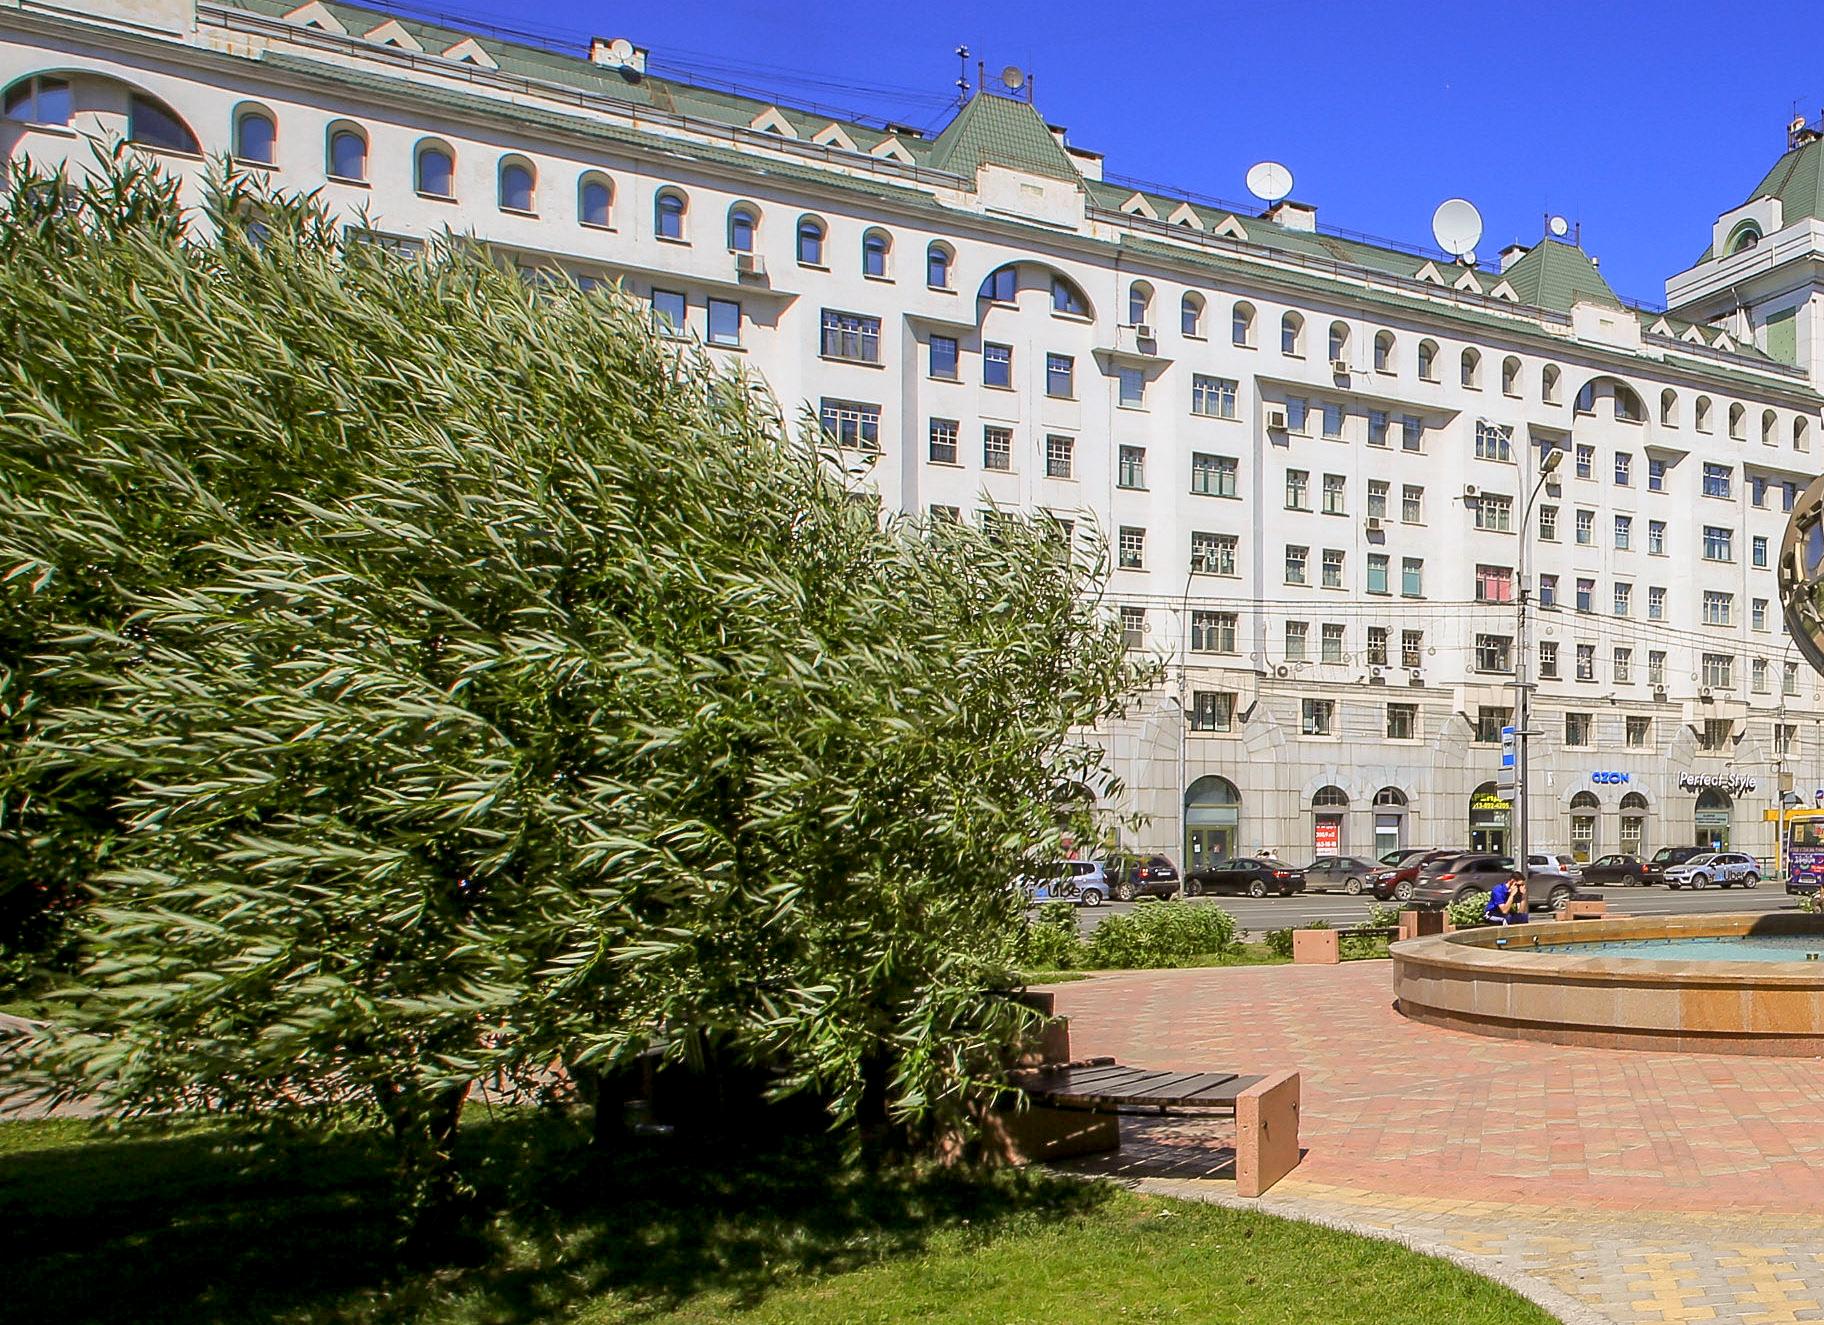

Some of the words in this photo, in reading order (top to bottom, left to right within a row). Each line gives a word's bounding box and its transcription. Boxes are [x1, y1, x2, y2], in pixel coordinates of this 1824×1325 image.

[1591, 772, 1630, 784] OZON
[1679, 771, 1722, 788] Perfect
[1728, 773, 1757, 791] Style
[1723, 870, 1745, 880] Uber
